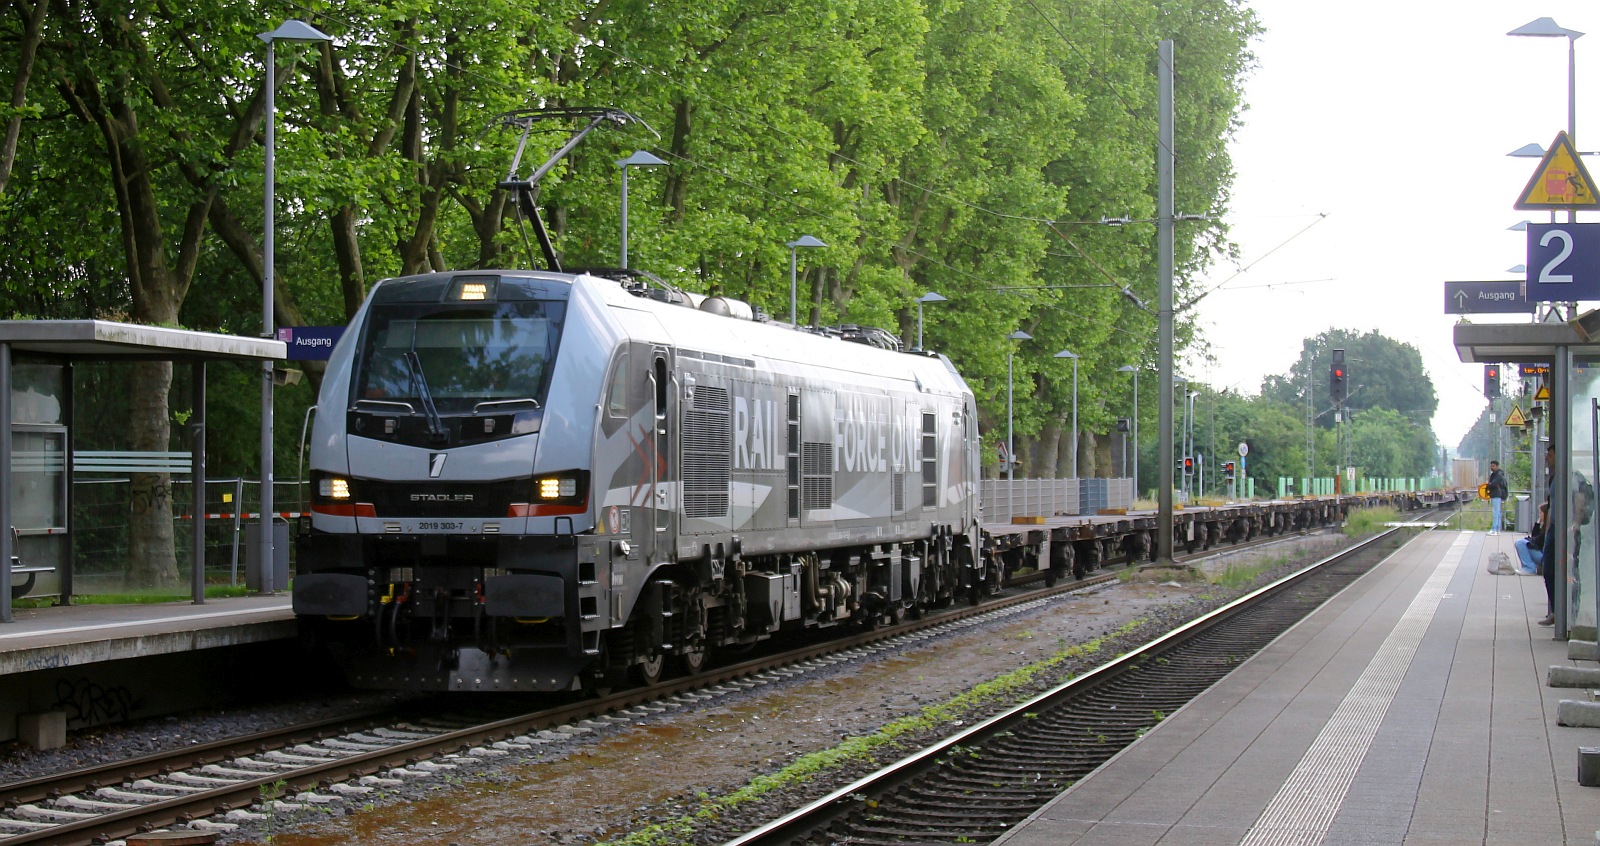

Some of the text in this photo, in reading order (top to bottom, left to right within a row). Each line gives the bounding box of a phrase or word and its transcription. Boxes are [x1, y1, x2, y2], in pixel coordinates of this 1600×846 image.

[1539, 229, 1574, 283] 2
[1478, 291, 1515, 301] Ausgang
[296, 336, 332, 348] Ausgang
[734, 396, 922, 473] RAIL FORCE ONE
[410, 494, 474, 502] STADLER
[419, 522, 464, 530] 2019 303-7
